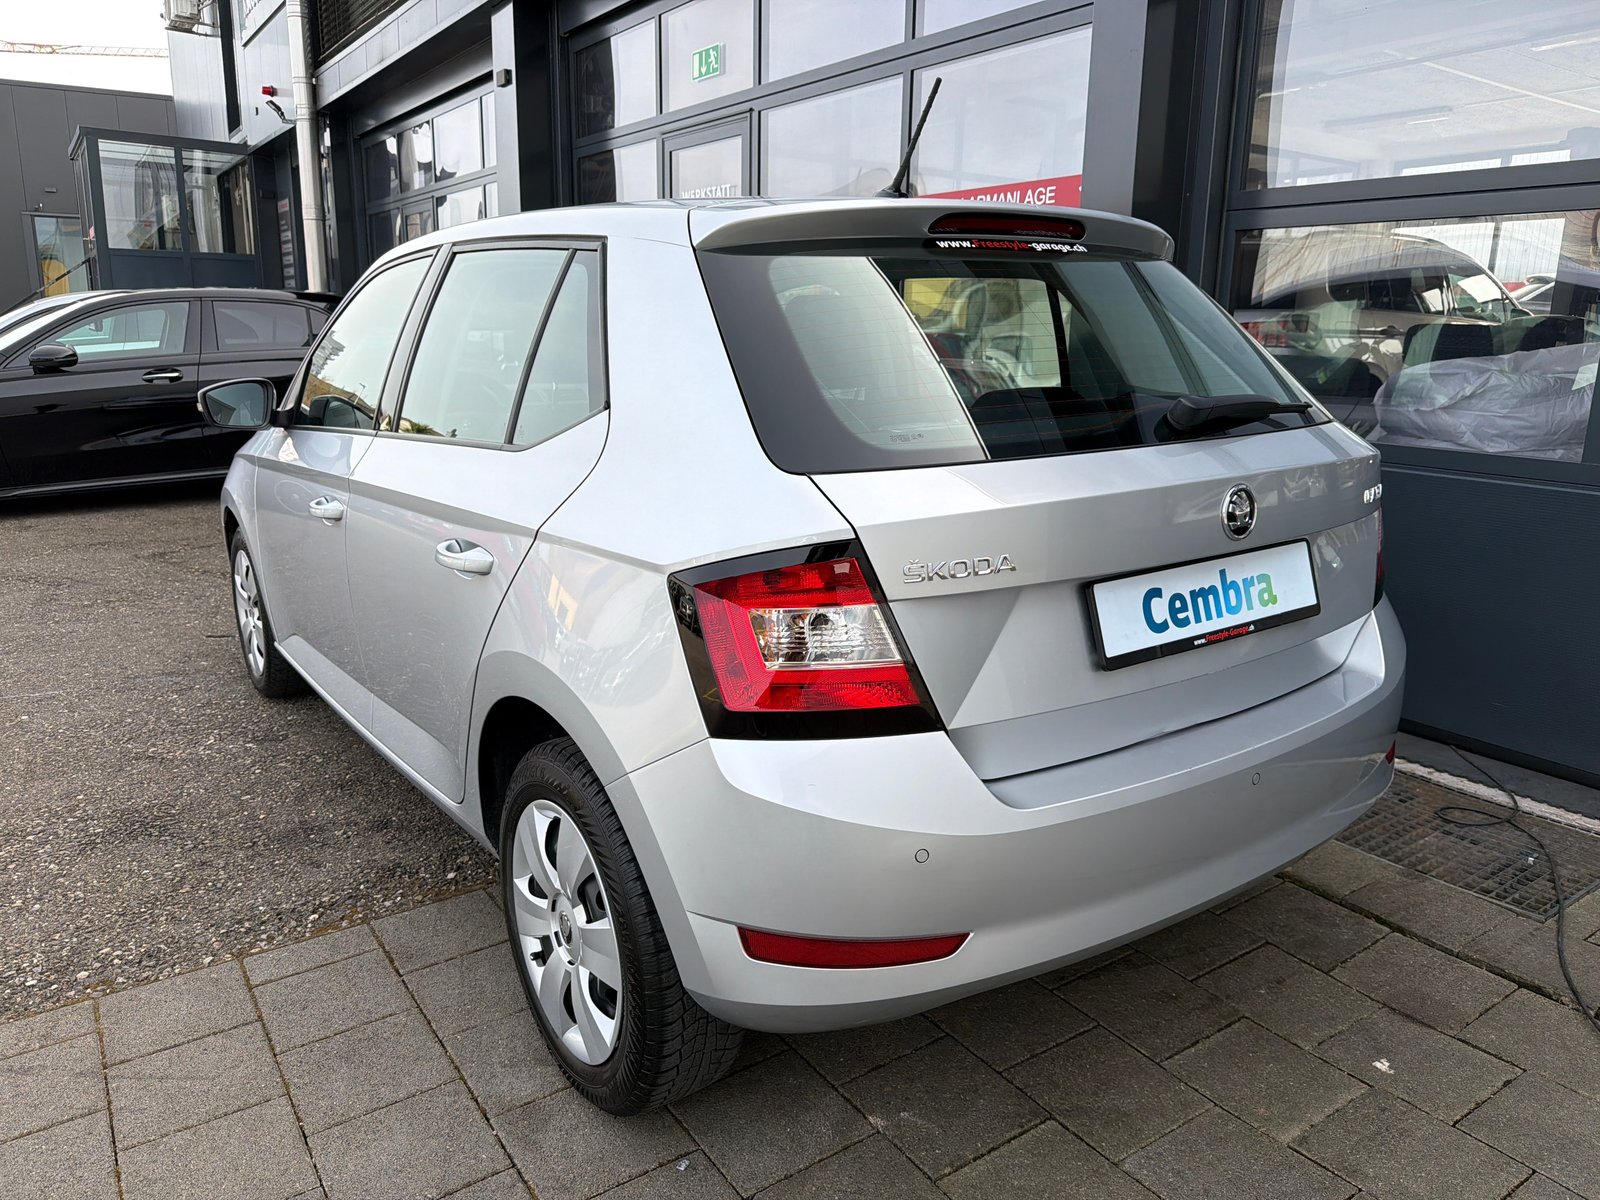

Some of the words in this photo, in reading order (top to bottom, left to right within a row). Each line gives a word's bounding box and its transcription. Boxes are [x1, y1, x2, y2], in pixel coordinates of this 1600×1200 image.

[936, 239, 1088, 252] www.Freestyle-garage.ch
[903, 554, 1017, 584] ŠKODA
[1142, 568, 1278, 634] Cembra
